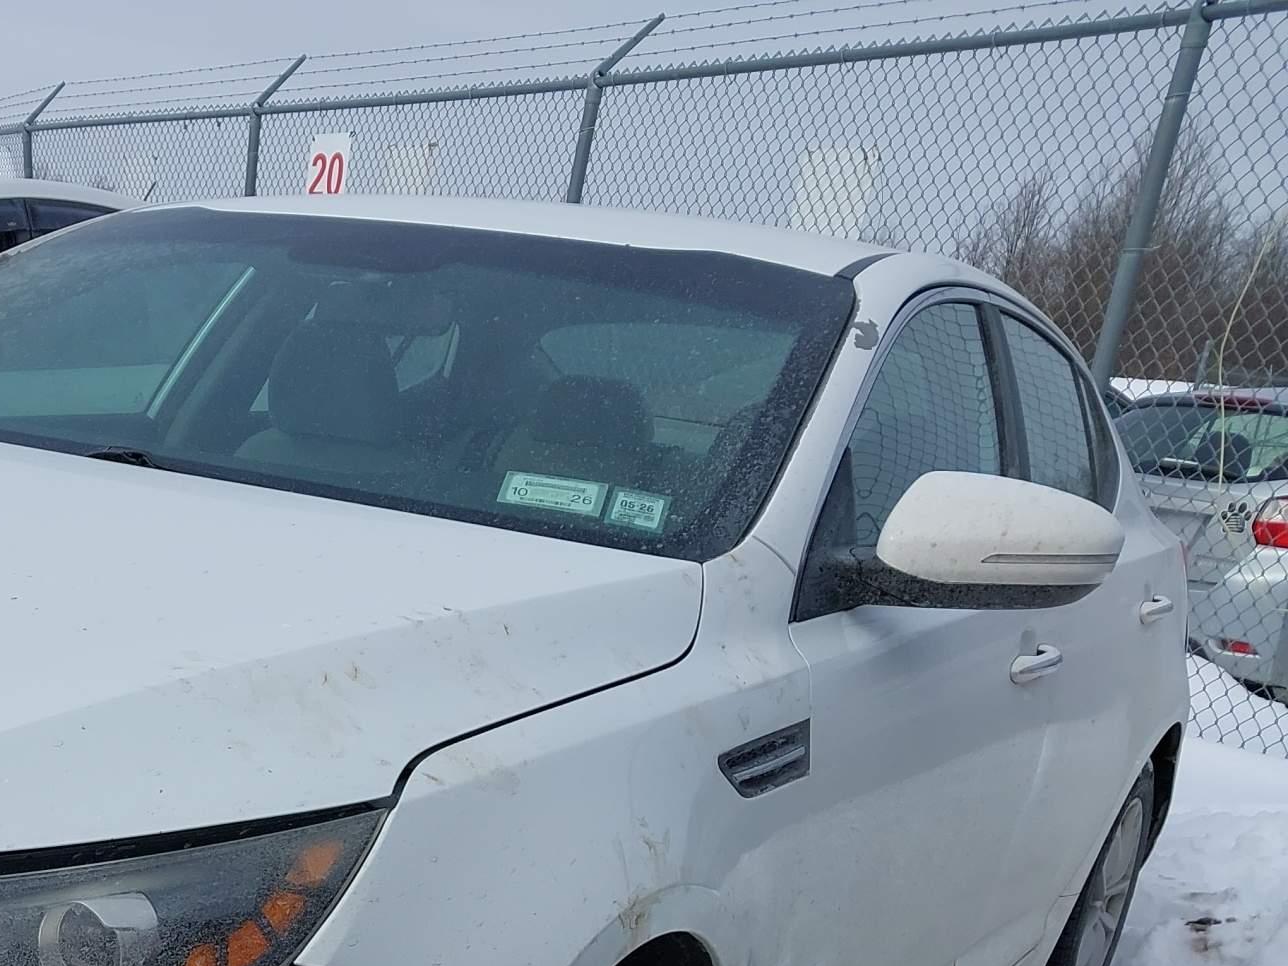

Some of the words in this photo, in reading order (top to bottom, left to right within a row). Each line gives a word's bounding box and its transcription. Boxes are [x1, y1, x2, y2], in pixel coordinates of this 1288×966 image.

[309, 152, 344, 194] 20
[512, 487, 528, 496] 10
[571, 494, 593, 505] 26
